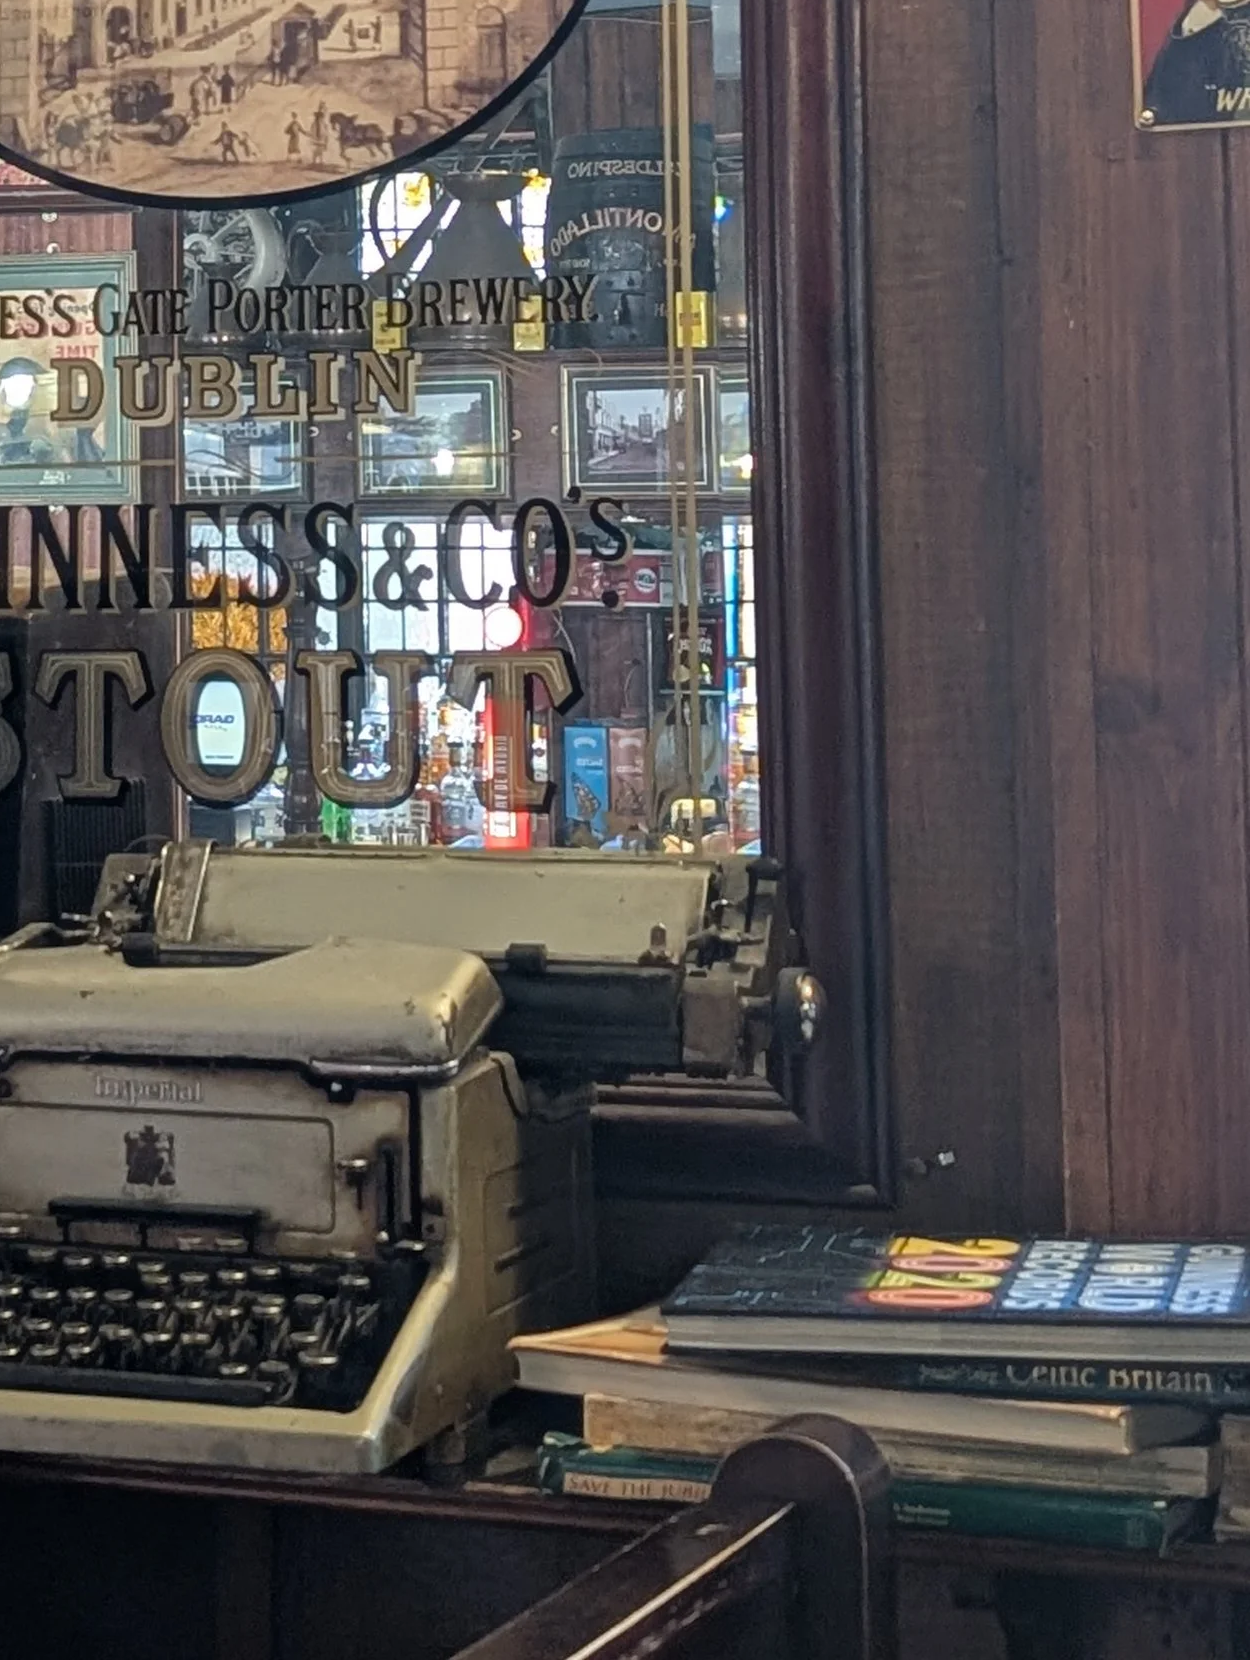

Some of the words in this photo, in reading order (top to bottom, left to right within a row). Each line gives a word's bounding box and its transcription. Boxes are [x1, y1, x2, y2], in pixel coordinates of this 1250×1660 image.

[93, 282, 190, 337] GATE
[207, 276, 368, 333] PORTER
[50, 349, 418, 427] DUBLIN
[867, 1236, 1022, 1309] 2020
[1002, 1239, 1091, 1311] RECORDS
[1079, 1242, 1181, 1312] WORLD
[569, 1477, 611, 1494] SAVE
